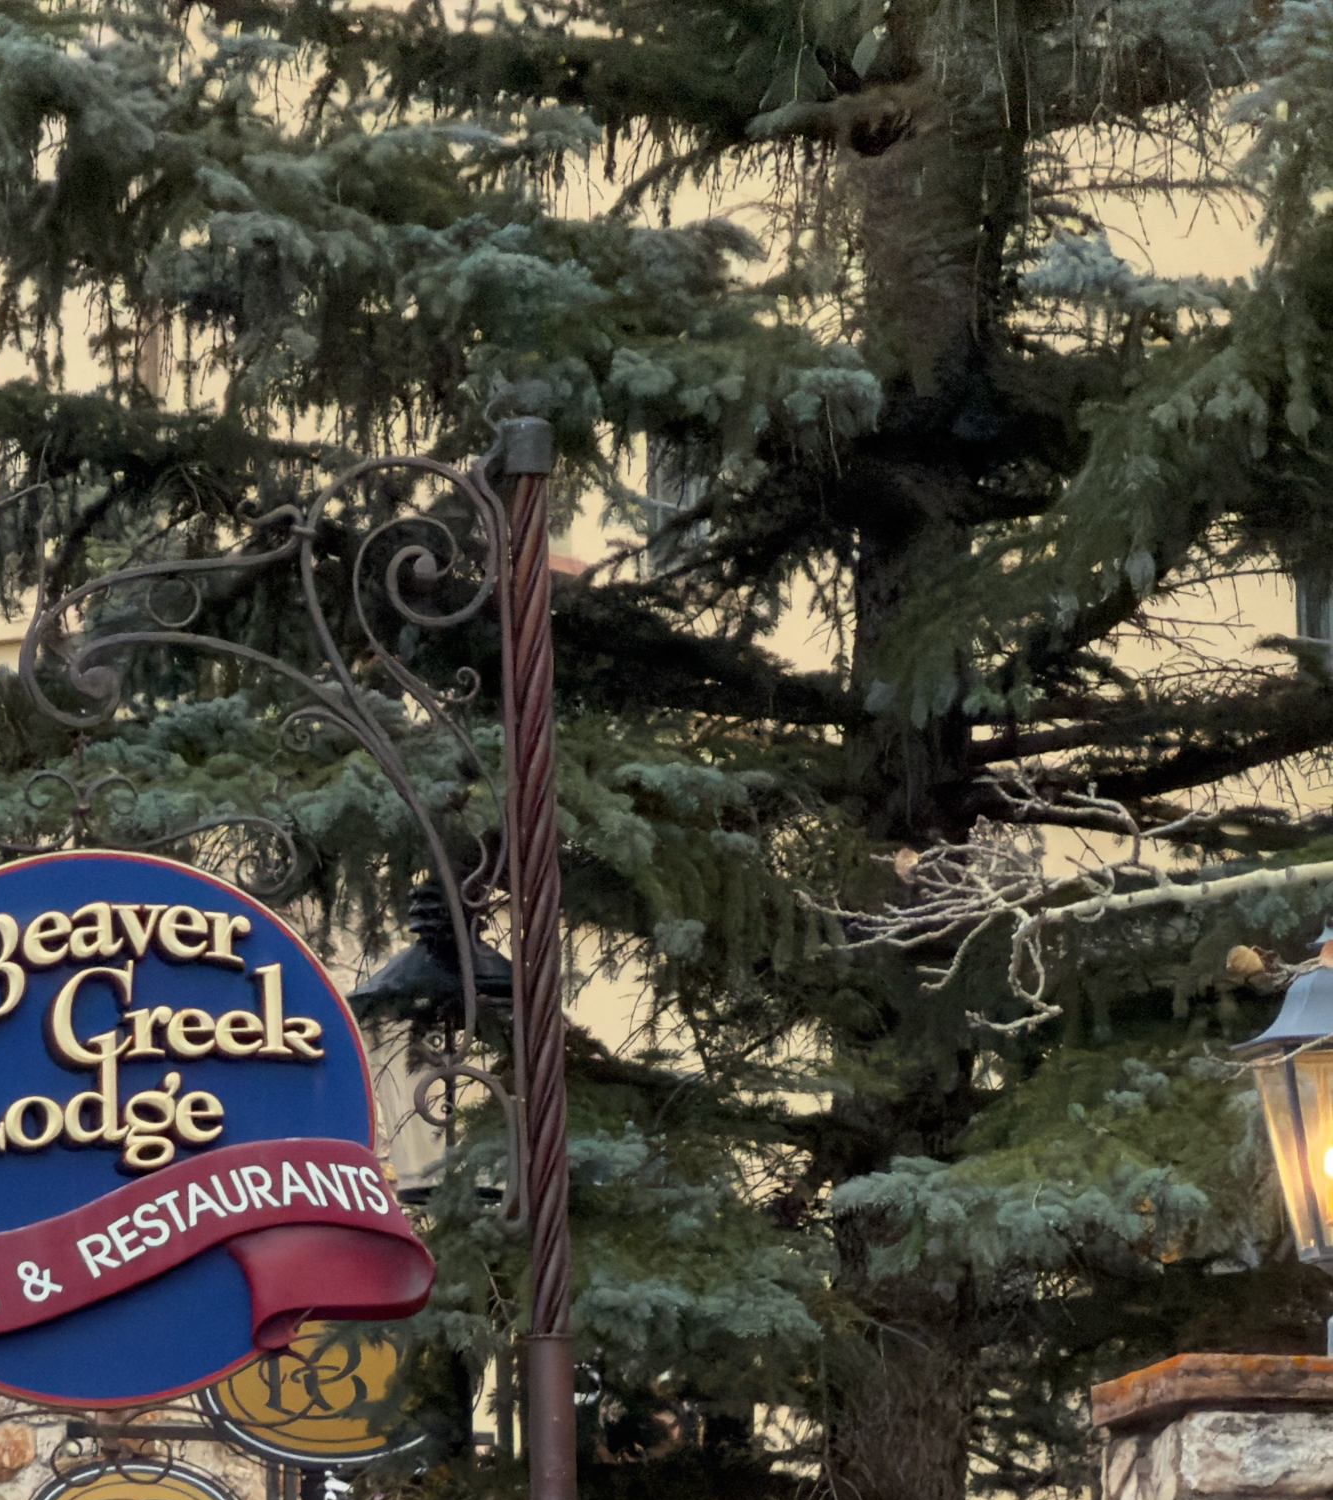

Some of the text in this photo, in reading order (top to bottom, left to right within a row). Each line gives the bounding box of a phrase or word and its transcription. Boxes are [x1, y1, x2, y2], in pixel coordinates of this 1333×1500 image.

[46, 959, 326, 1066] Creek
[16, 1260, 62, 1303] &
[76, 1161, 390, 1279] RESTAURANTS
